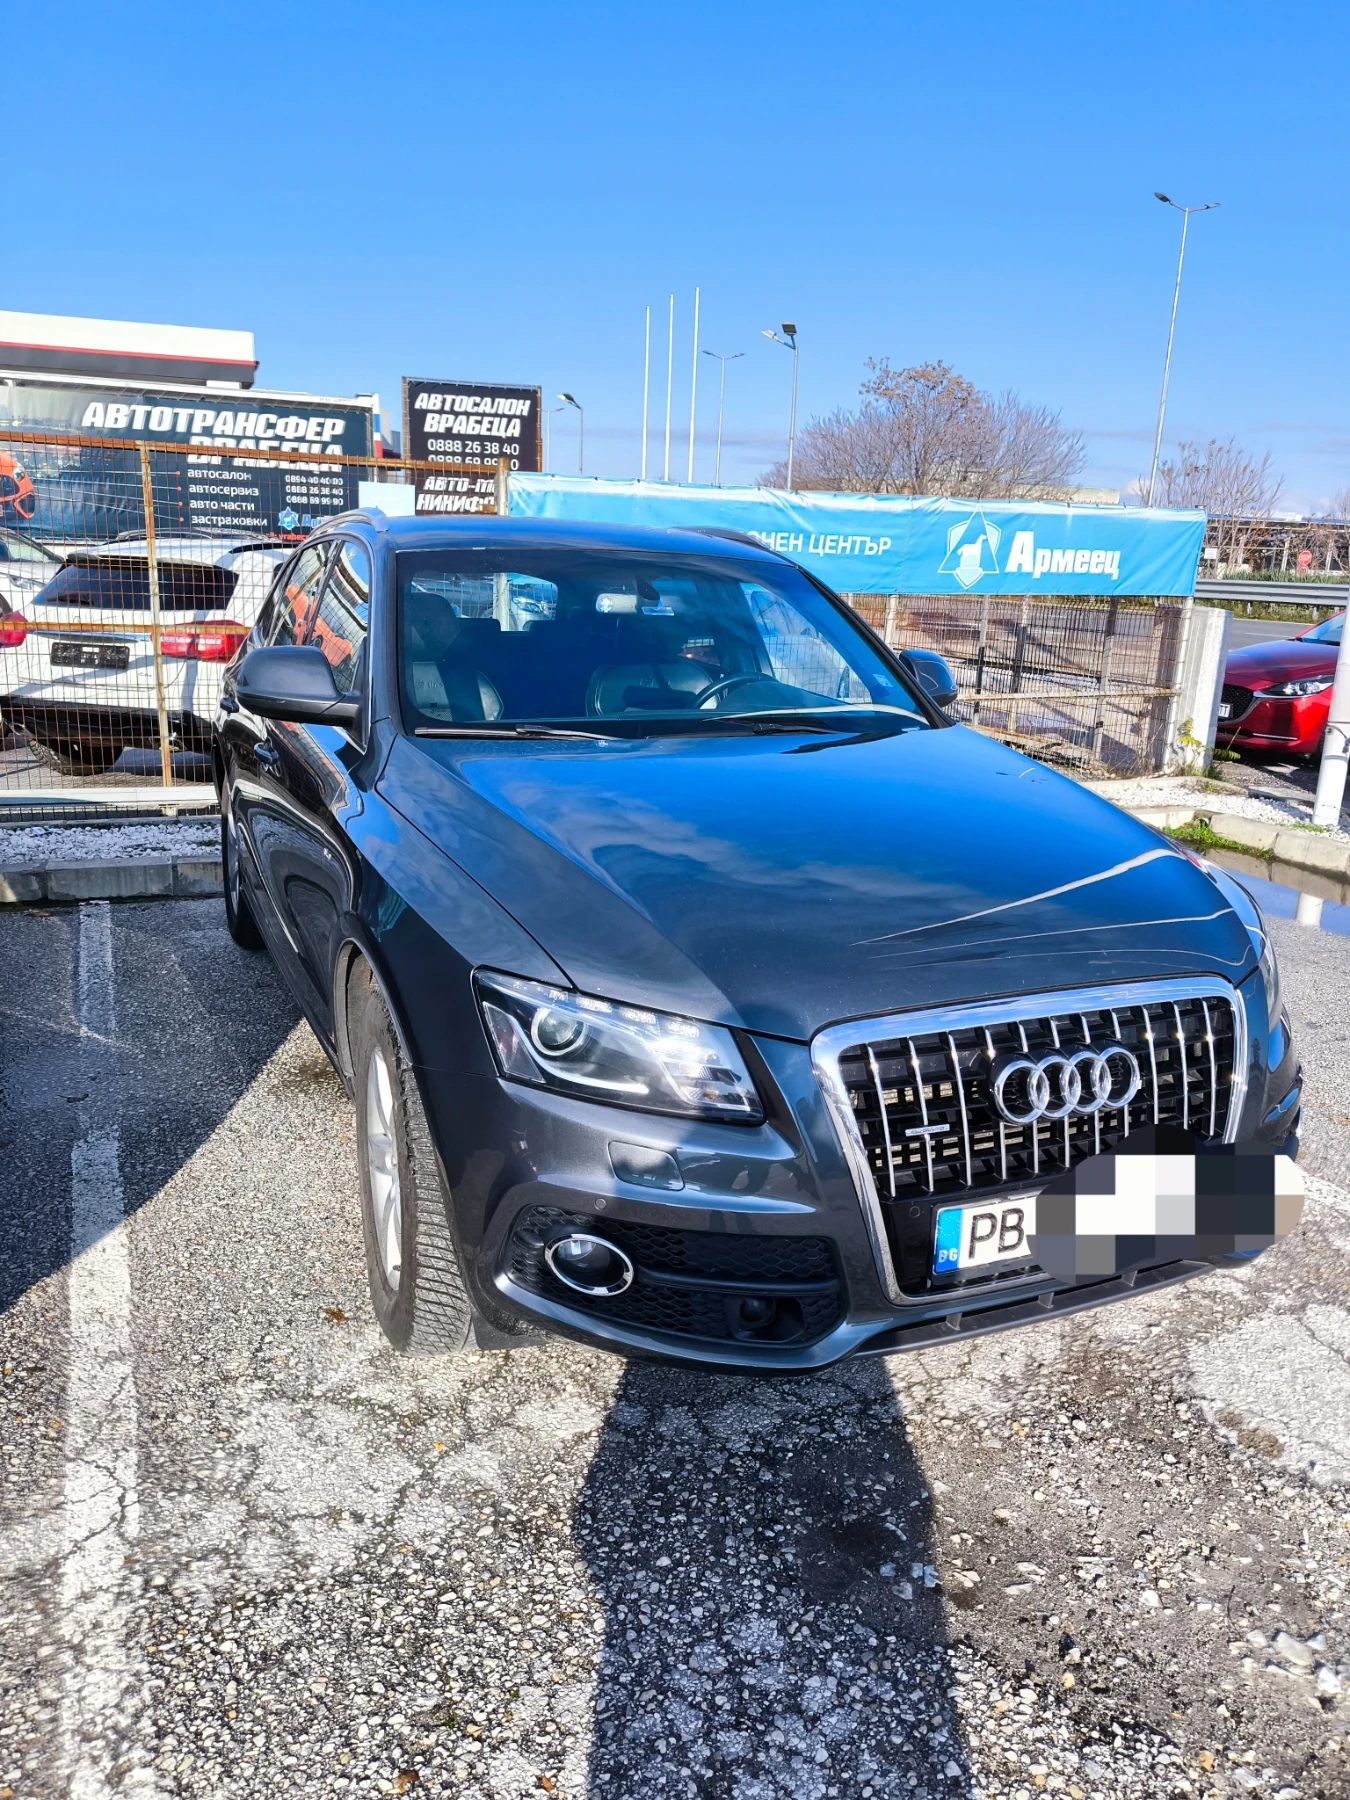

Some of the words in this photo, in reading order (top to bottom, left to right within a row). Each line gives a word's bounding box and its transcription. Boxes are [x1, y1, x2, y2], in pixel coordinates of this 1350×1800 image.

[414, 392, 531, 416] АВТОСАЛОН
[81, 402, 346, 442] АВТОТРАНСФЕР
[423, 413, 521, 438] ВРАБЕЦА
[427, 439, 462, 452] 0888
[464, 441, 481, 453] 26
[483, 442, 499, 454] 38
[502, 443, 519, 455] 40
[187, 469, 252, 480] автосалон
[189, 484, 259, 497] автосервиз
[309, 486, 319, 494] 26
[423, 475, 495, 493] АВТО-М
[189, 500, 218, 509] авто
[220, 502, 255, 511] части
[191, 515, 268, 527] застраховки
[808, 534, 892, 557] ЦЕНТЪР
[1005, 530, 1121, 580] Армеец
[938, 1247, 958, 1263] BG
[968, 1207, 1025, 1260] PB
